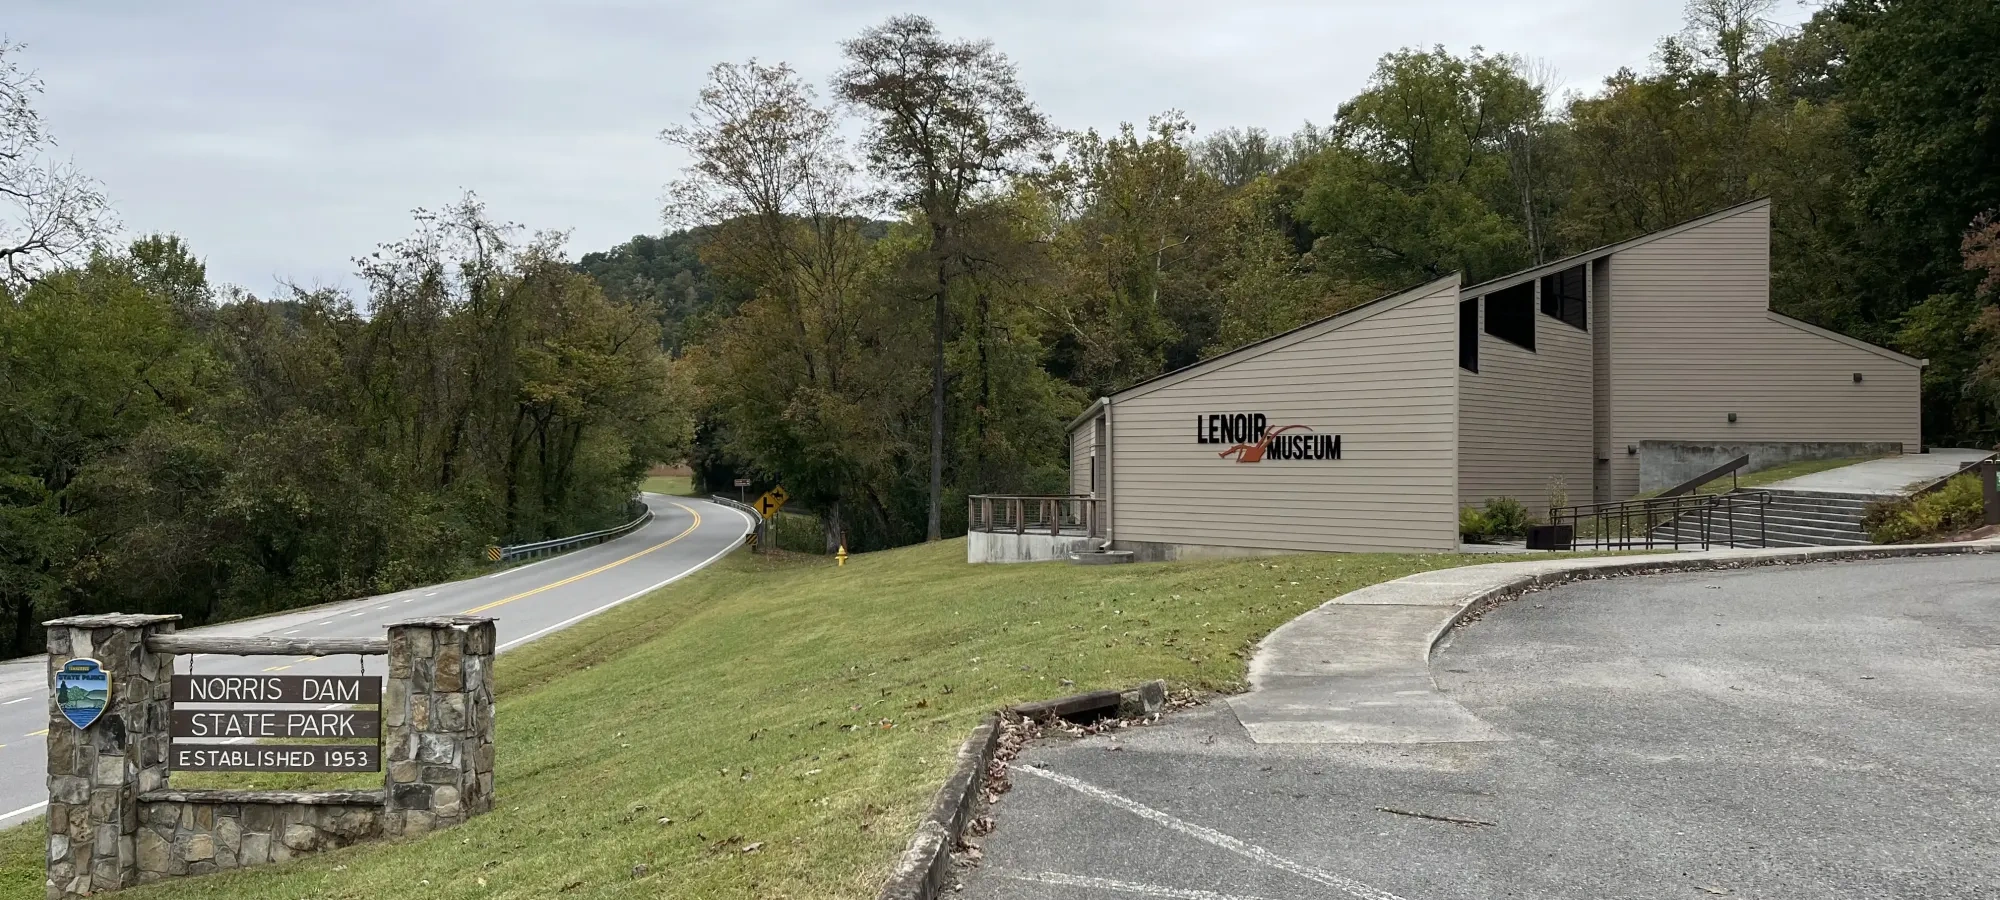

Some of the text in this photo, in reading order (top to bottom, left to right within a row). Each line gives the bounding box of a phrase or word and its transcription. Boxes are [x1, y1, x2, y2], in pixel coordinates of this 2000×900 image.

[1197, 413, 1266, 444] LENOIR
[1267, 435, 1341, 460] MUSEUM
[190, 678, 360, 701] NORRIS DAM
[191, 713, 355, 736] STATE PARK
[179, 750, 368, 767] ESTABLISHED 1953
